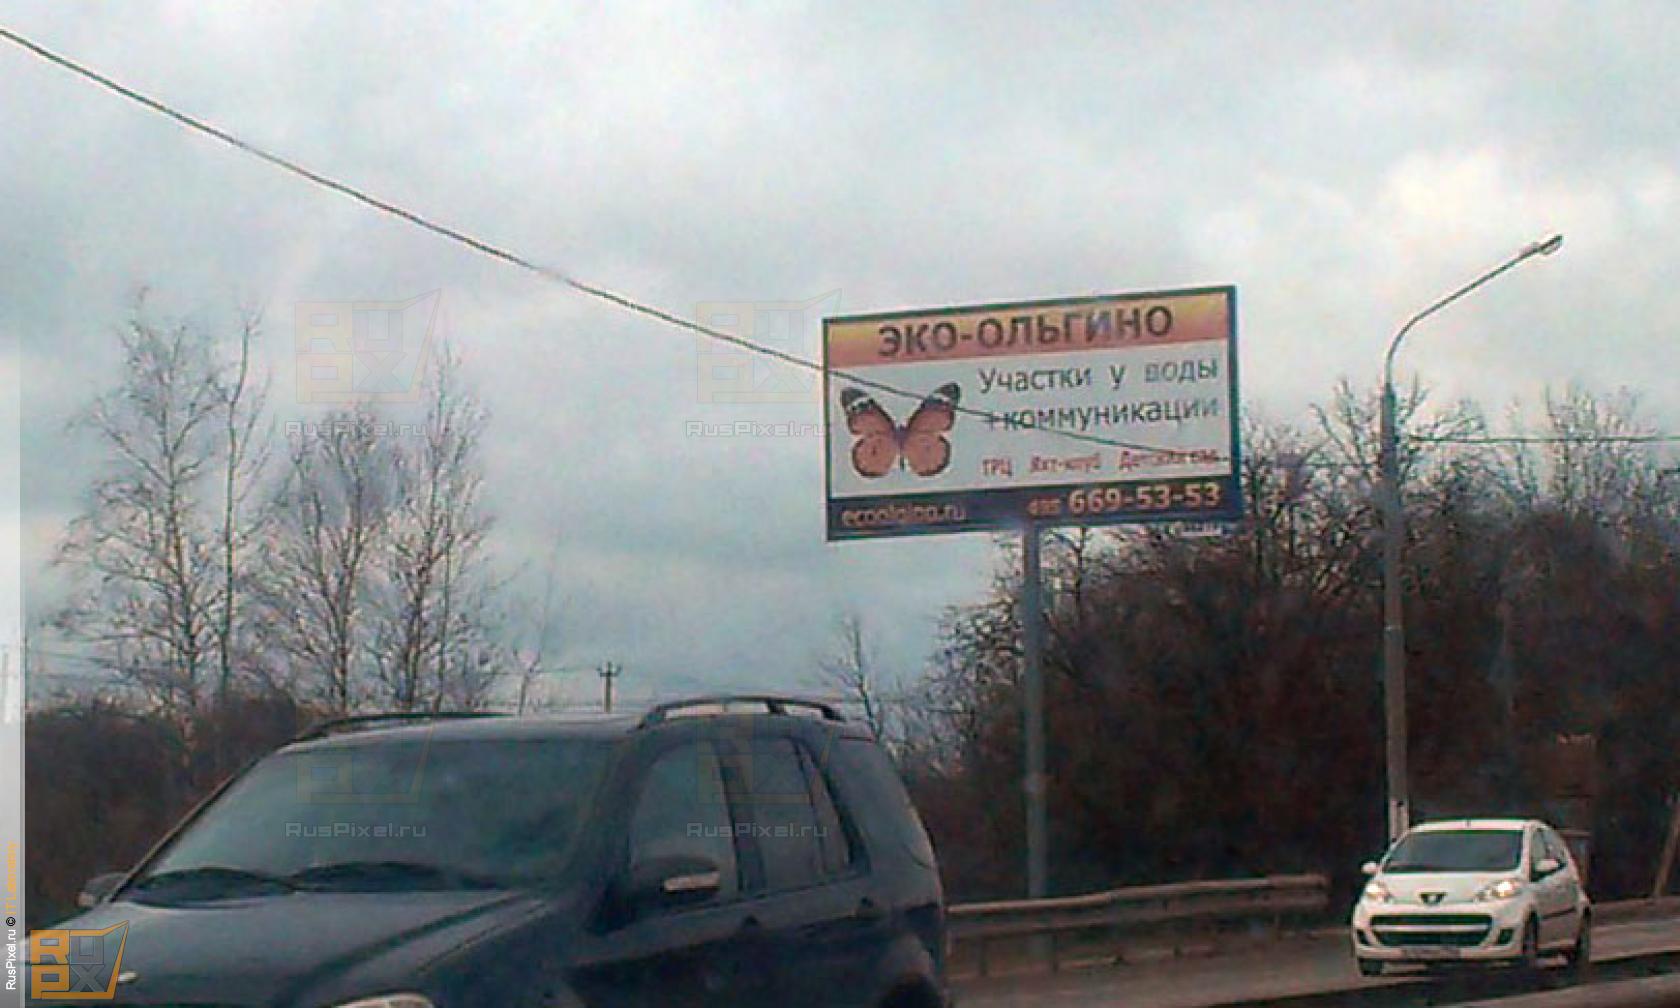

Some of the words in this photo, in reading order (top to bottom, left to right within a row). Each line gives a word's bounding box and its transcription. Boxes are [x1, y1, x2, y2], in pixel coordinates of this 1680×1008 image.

[877, 304, 1173, 357] ЭКО-ОЛЬГИНО
[978, 366, 1093, 394] Участки
[1108, 363, 1127, 390] у
[1144, 358, 1218, 384] воды
[1068, 481, 1222, 516] 669-53-53
